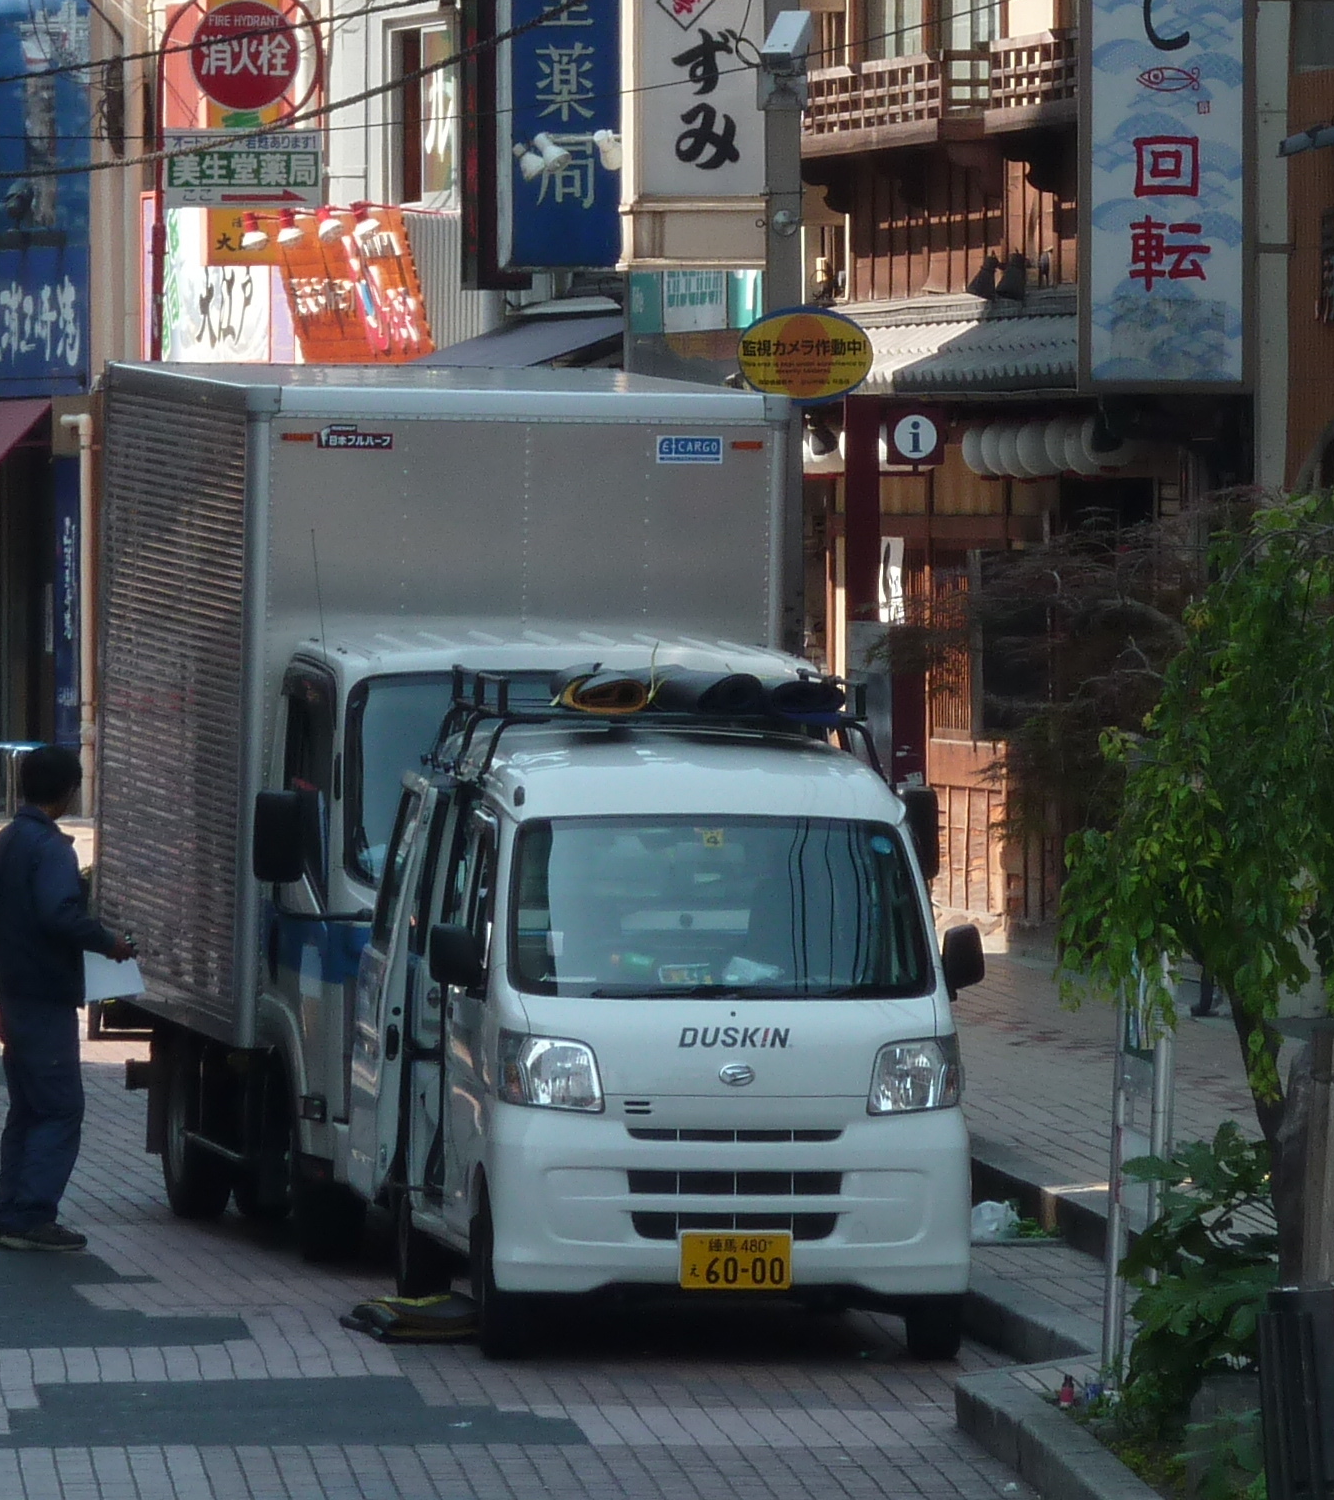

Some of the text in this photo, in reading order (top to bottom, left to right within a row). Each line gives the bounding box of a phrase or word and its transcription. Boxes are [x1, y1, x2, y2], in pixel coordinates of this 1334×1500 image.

[208, 14, 281, 27] FIRE HYDRANT
[200, 33, 292, 77] 消火栓
[172, 152, 317, 186] 美生堂薬局
[182, 189, 215, 202] ここ
[1128, 134, 1211, 292] 回転
[742, 338, 868, 358] 監視カメラ作動中!
[329, 434, 391, 447] 日本フルハーフ
[678, 1026, 792, 1051] DUSKIN
[708, 1238, 767, 1253] 練馬 480
[706, 1256, 786, 1285] 60-00
